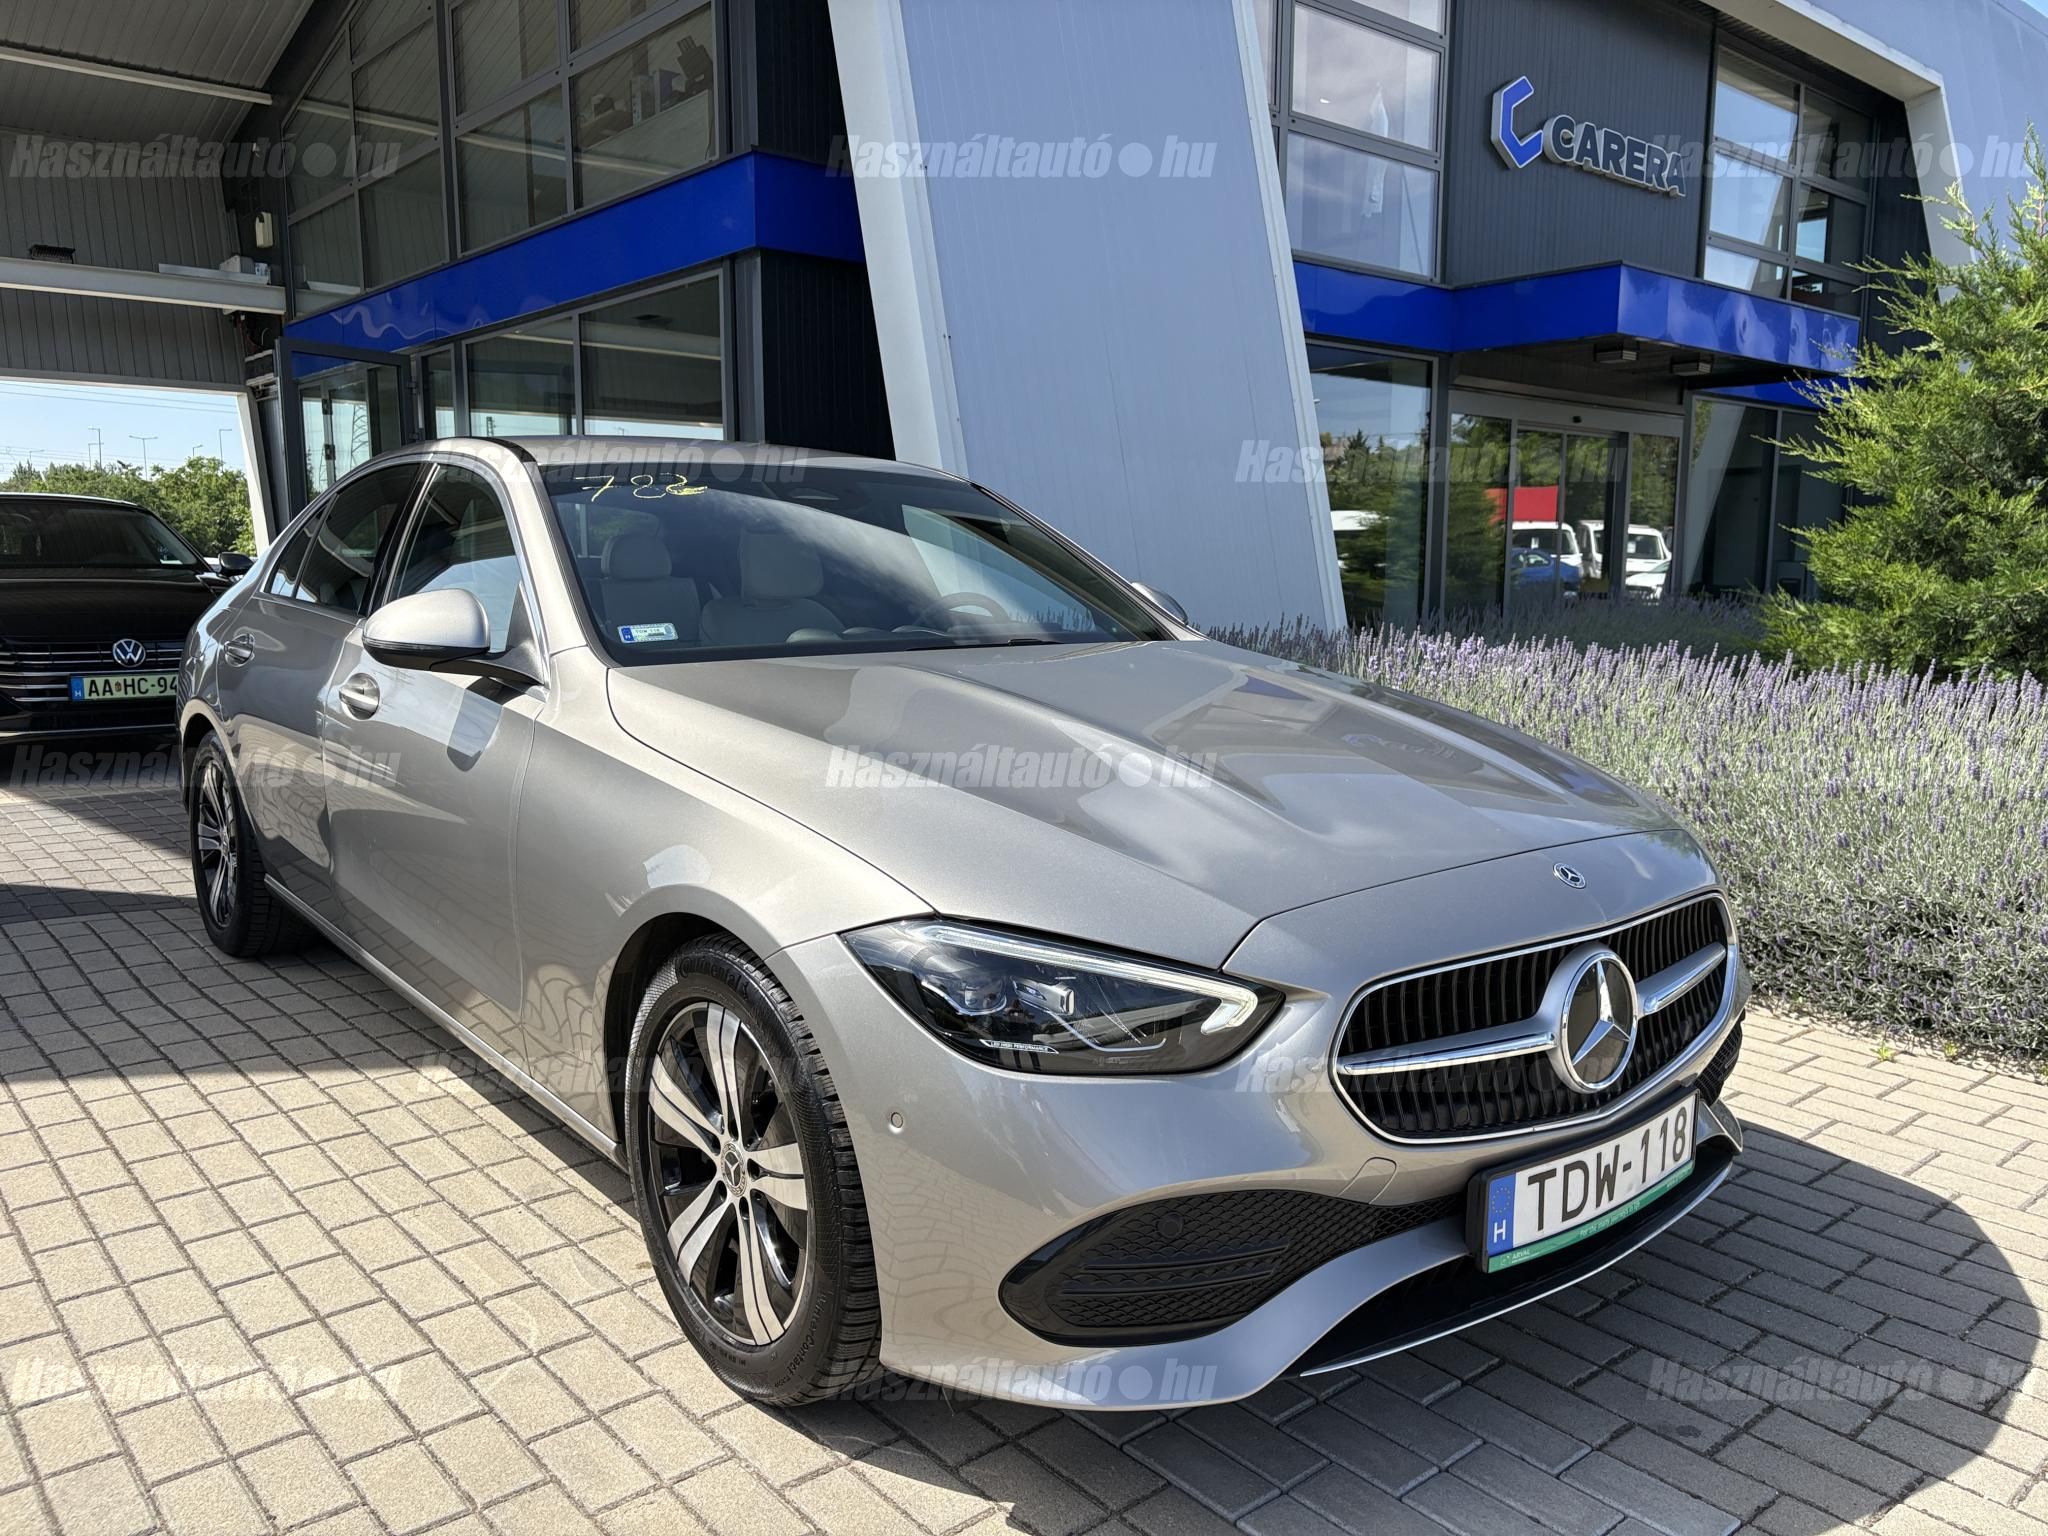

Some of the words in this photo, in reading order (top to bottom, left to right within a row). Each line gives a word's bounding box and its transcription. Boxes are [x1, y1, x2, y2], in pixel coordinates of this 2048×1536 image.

[1545, 114, 1686, 197] CARERA
[74, 689, 82, 697] H
[88, 678, 114, 697] AA
[1527, 1106, 1687, 1232] TDW-118
[1494, 1219, 1506, 1243] H
[1511, 1249, 1530, 1259] ARVAL
